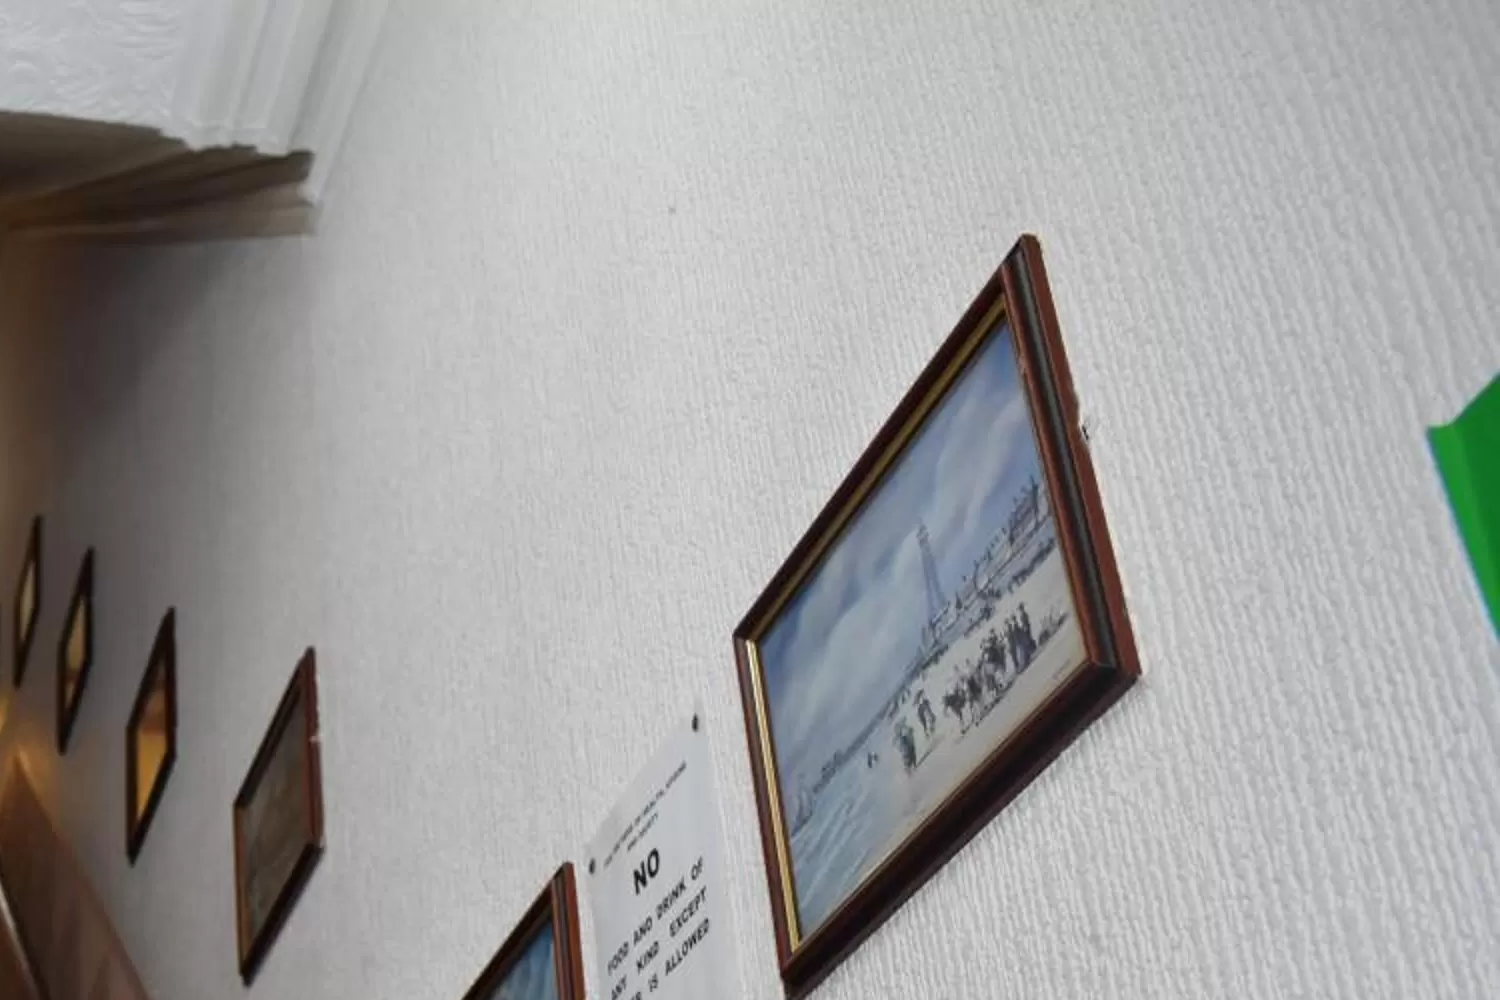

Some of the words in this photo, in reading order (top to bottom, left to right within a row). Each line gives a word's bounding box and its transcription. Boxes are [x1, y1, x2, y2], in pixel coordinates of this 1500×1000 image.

[633, 848, 660, 895] NO
[607, 942, 629, 976] FOOD
[633, 916, 653, 946] AND
[655, 877, 687, 920] DRINK
[691, 857, 703, 880] OF
[636, 941, 659, 974] KIND
[669, 885, 707, 937] EXCEPT
[648, 972, 659, 992] IS
[665, 917, 709, 976] ALLOWED
